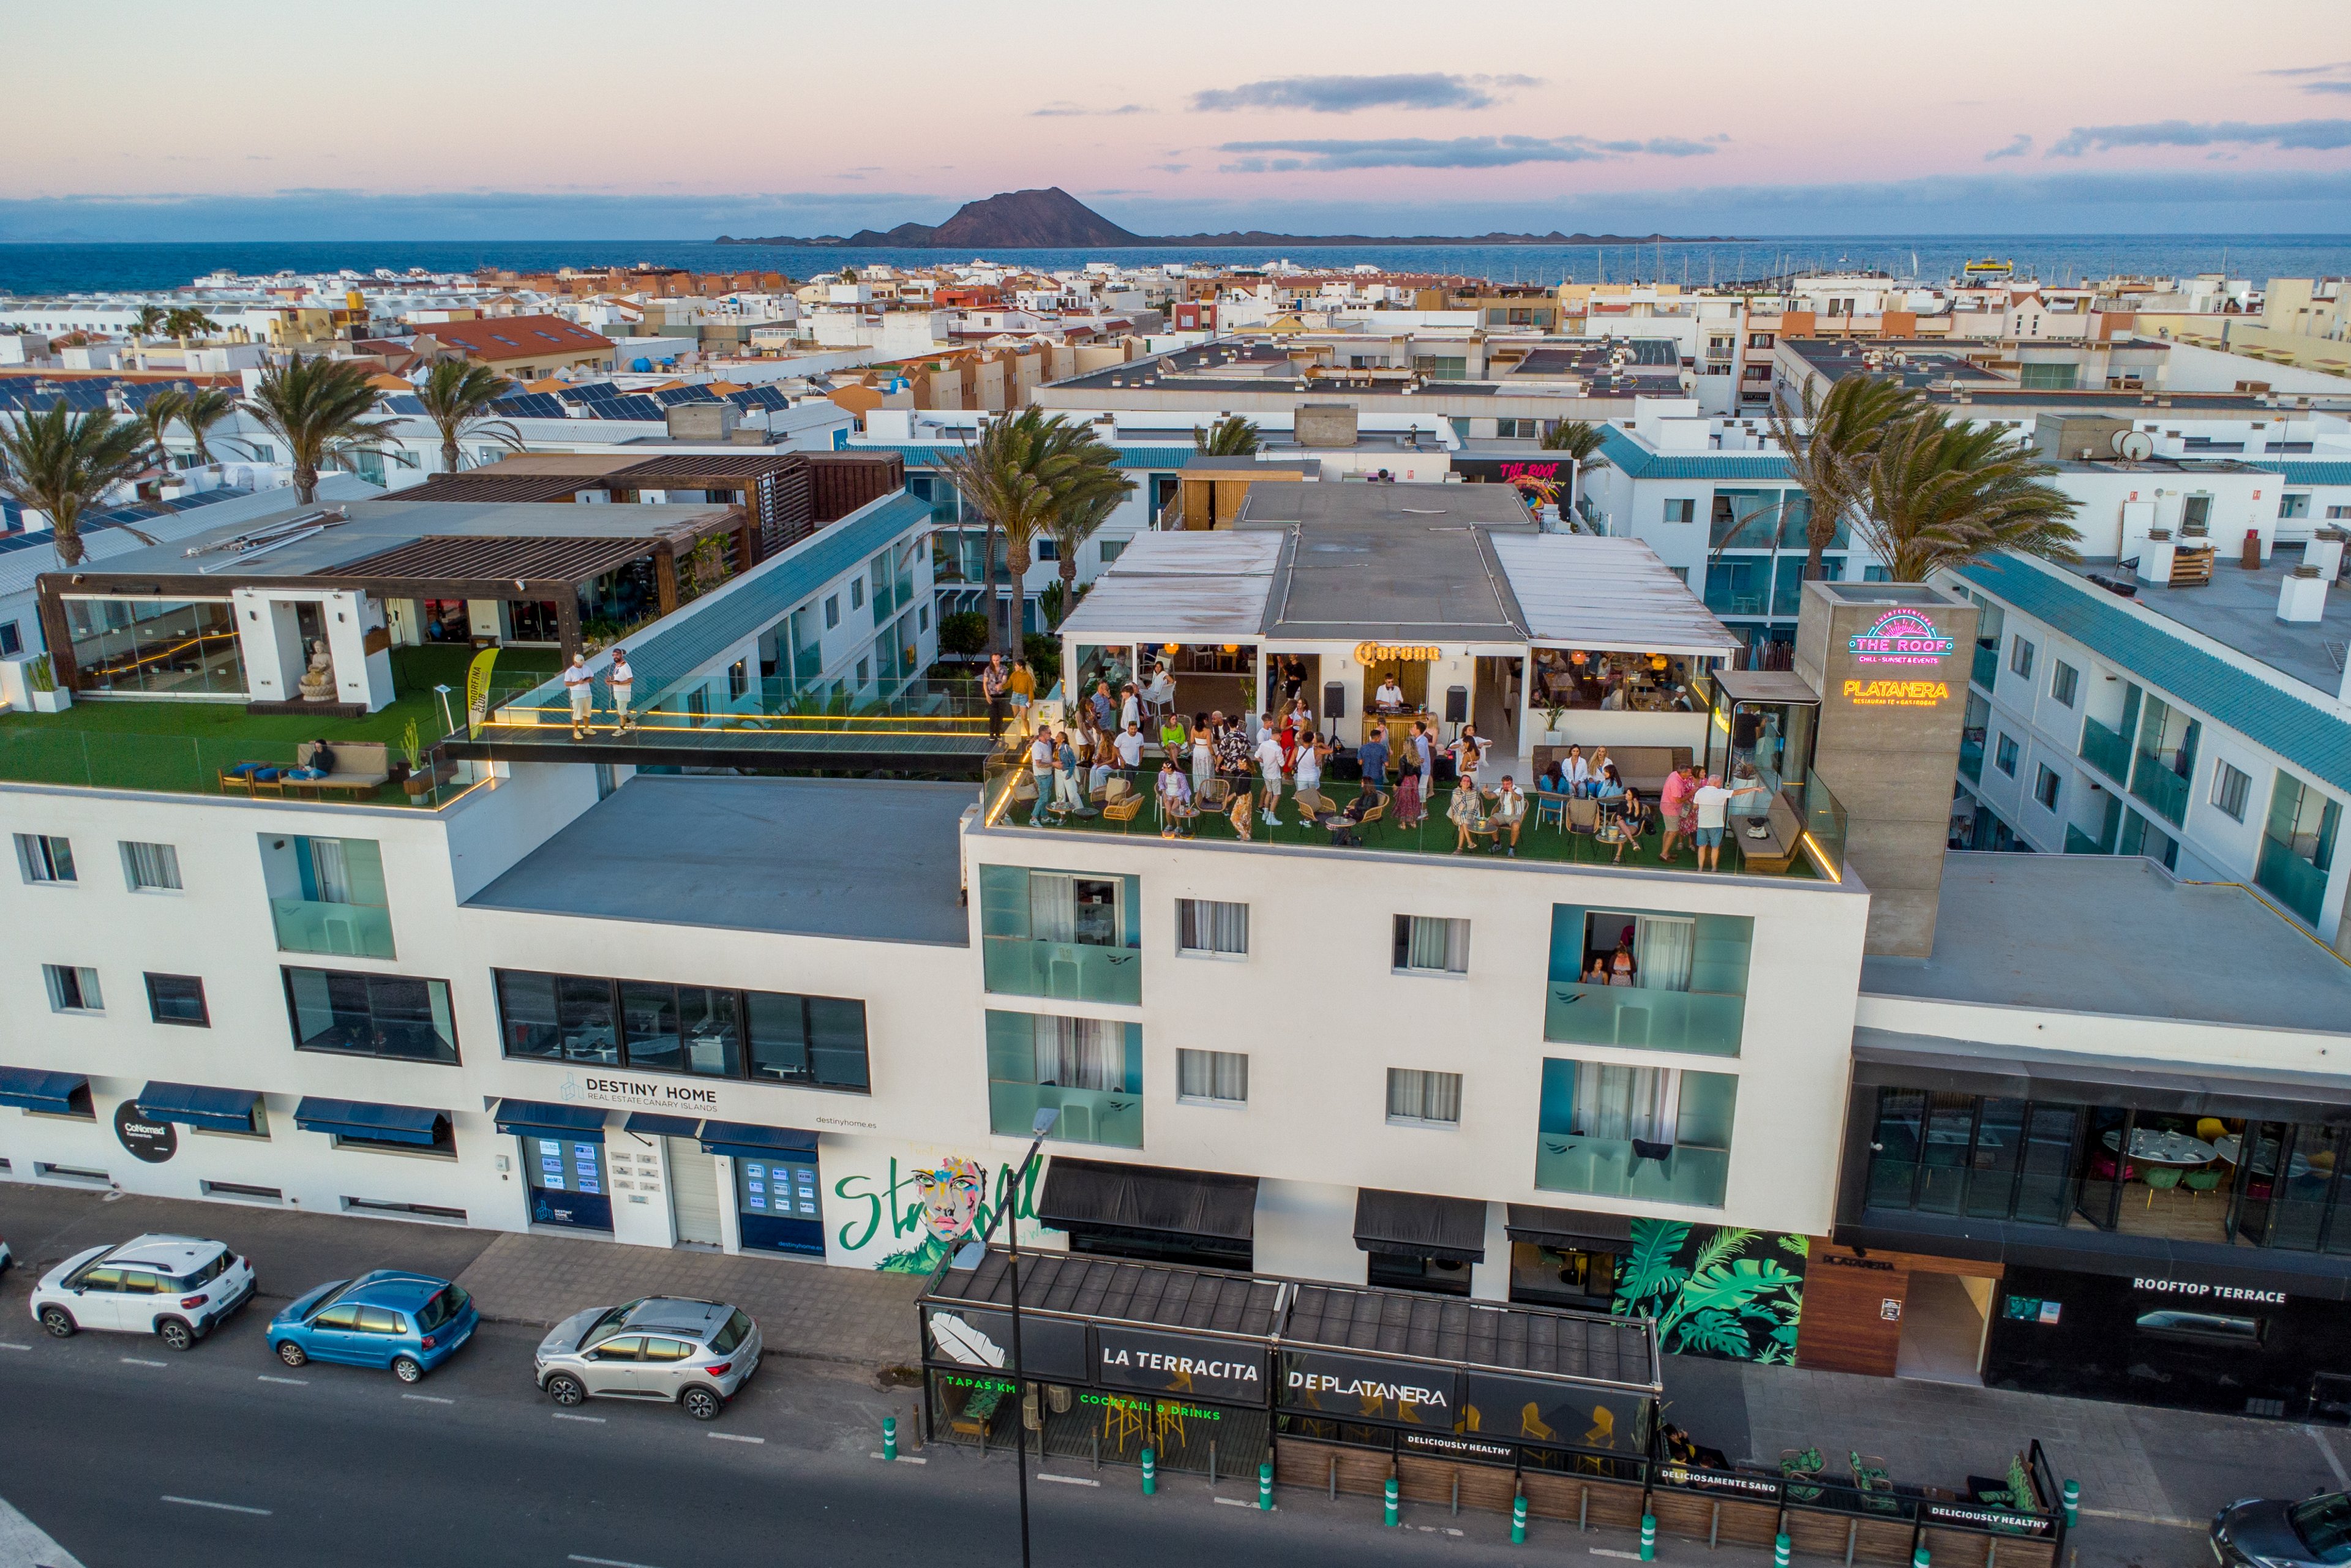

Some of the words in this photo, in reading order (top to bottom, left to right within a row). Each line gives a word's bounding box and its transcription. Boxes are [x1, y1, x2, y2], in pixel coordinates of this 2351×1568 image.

[1500, 462, 1525, 479] THE
[1528, 462, 1559, 479] ROOF
[1875, 609, 1933, 627] FUERTEVENTURA
[1354, 641, 1441, 668] Corona
[1857, 639, 1890, 651] THE
[1897, 639, 1946, 652] ROOF
[470, 666, 481, 711] ENDORFINA
[1843, 680, 1949, 699] PLATANERA
[478, 692, 486, 713] CLUB
[587, 1078, 658, 1097] DESTINY
[667, 1086, 716, 1103] HOME
[612, 1095, 642, 1105] ESTATE
[643, 1098, 678, 1108] CANARY
[681, 1103, 718, 1112] ISLANDS
[816, 1116, 877, 1128] destinyhome.es
[778, 1240, 823, 1251] destinyhome.es
[2134, 1278, 2210, 1295] ROOFTOP
[2213, 1286, 2286, 1303] TERRACE
[1103, 1348, 1130, 1366] LA
[1136, 1351, 1258, 1381] TERRACITA
[947, 1376, 992, 1390] TAPAS
[997, 1382, 1016, 1394] KM
[1288, 1371, 1318, 1390] DE
[1321, 1375, 1447, 1407] PLATANERA
[1080, 1394, 1151, 1411] COCKTAIL
[1171, 1406, 1220, 1420] DRINKS
[1408, 1435, 1468, 1450] DELICIOUSLY
[1469, 1444, 1511, 1456] HEALTHY
[1662, 1470, 1747, 1488] DELICIOSAMENTE
[1749, 1482, 1776, 1493] SANO
[1932, 1507, 2000, 1522] DELICIOUSLY
[2001, 1517, 2049, 1529] HEALTHY
